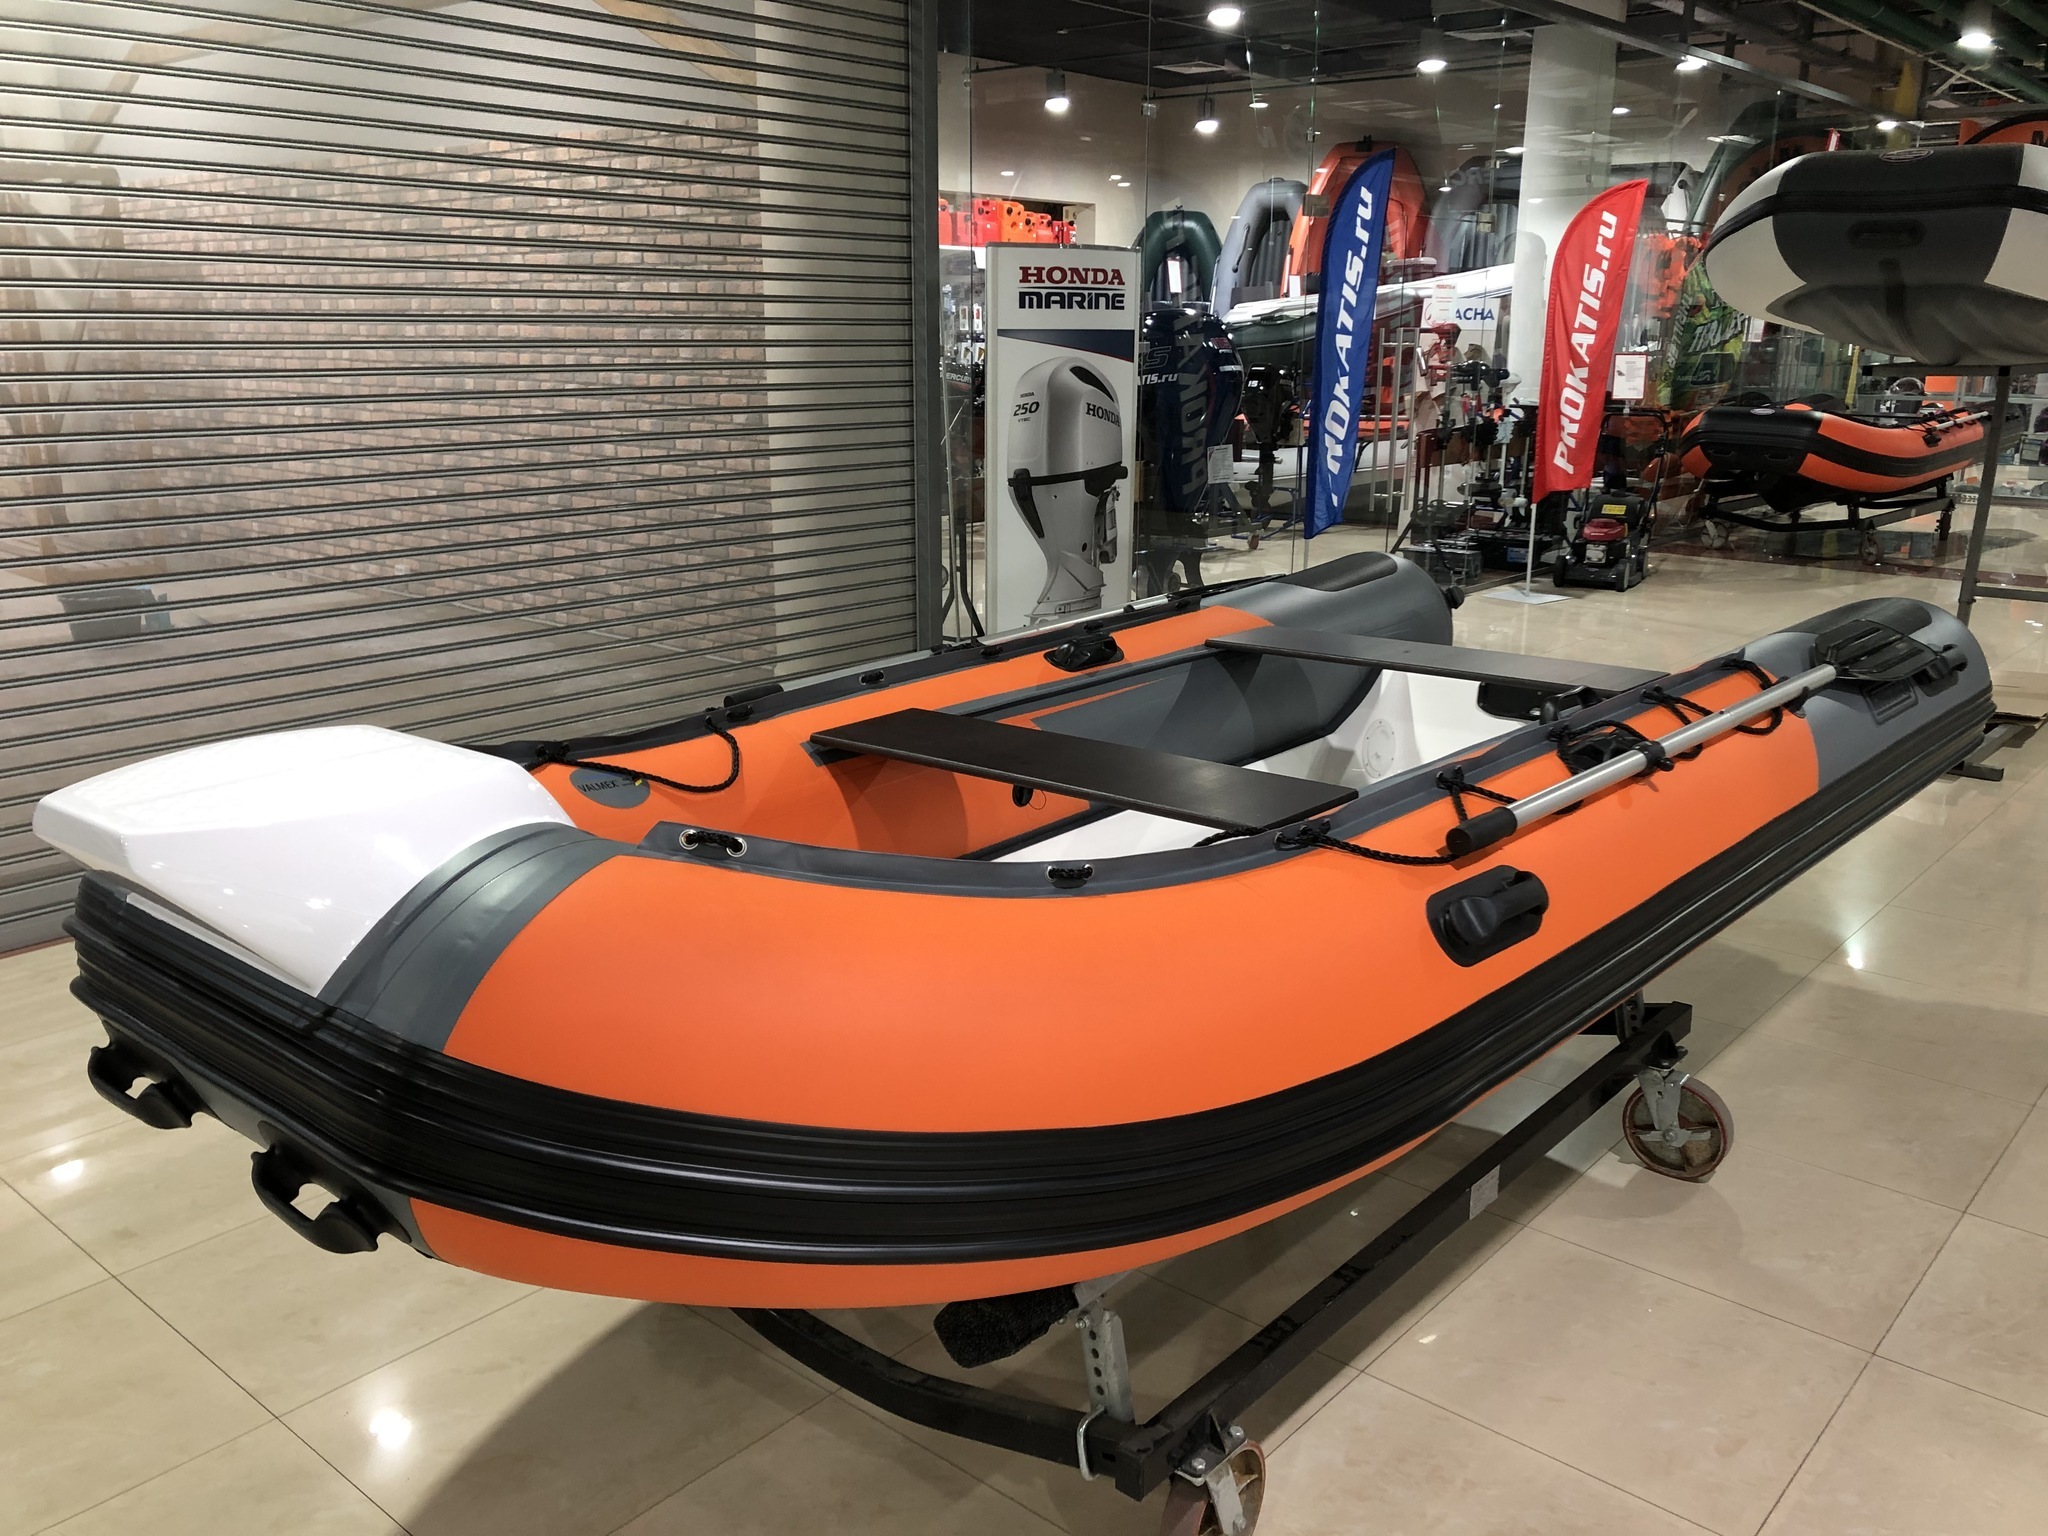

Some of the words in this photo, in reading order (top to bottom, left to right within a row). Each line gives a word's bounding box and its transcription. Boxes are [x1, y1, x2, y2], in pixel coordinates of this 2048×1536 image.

[1019, 266, 1125, 285] HONDA
[1019, 291, 1125, 310] MARINE
[1553, 210, 1618, 475] PROKATIS.ru
[1013, 401, 1040, 416] 250
[1086, 402, 1120, 427] HONDA
[578, 780, 619, 793] VALMEX
